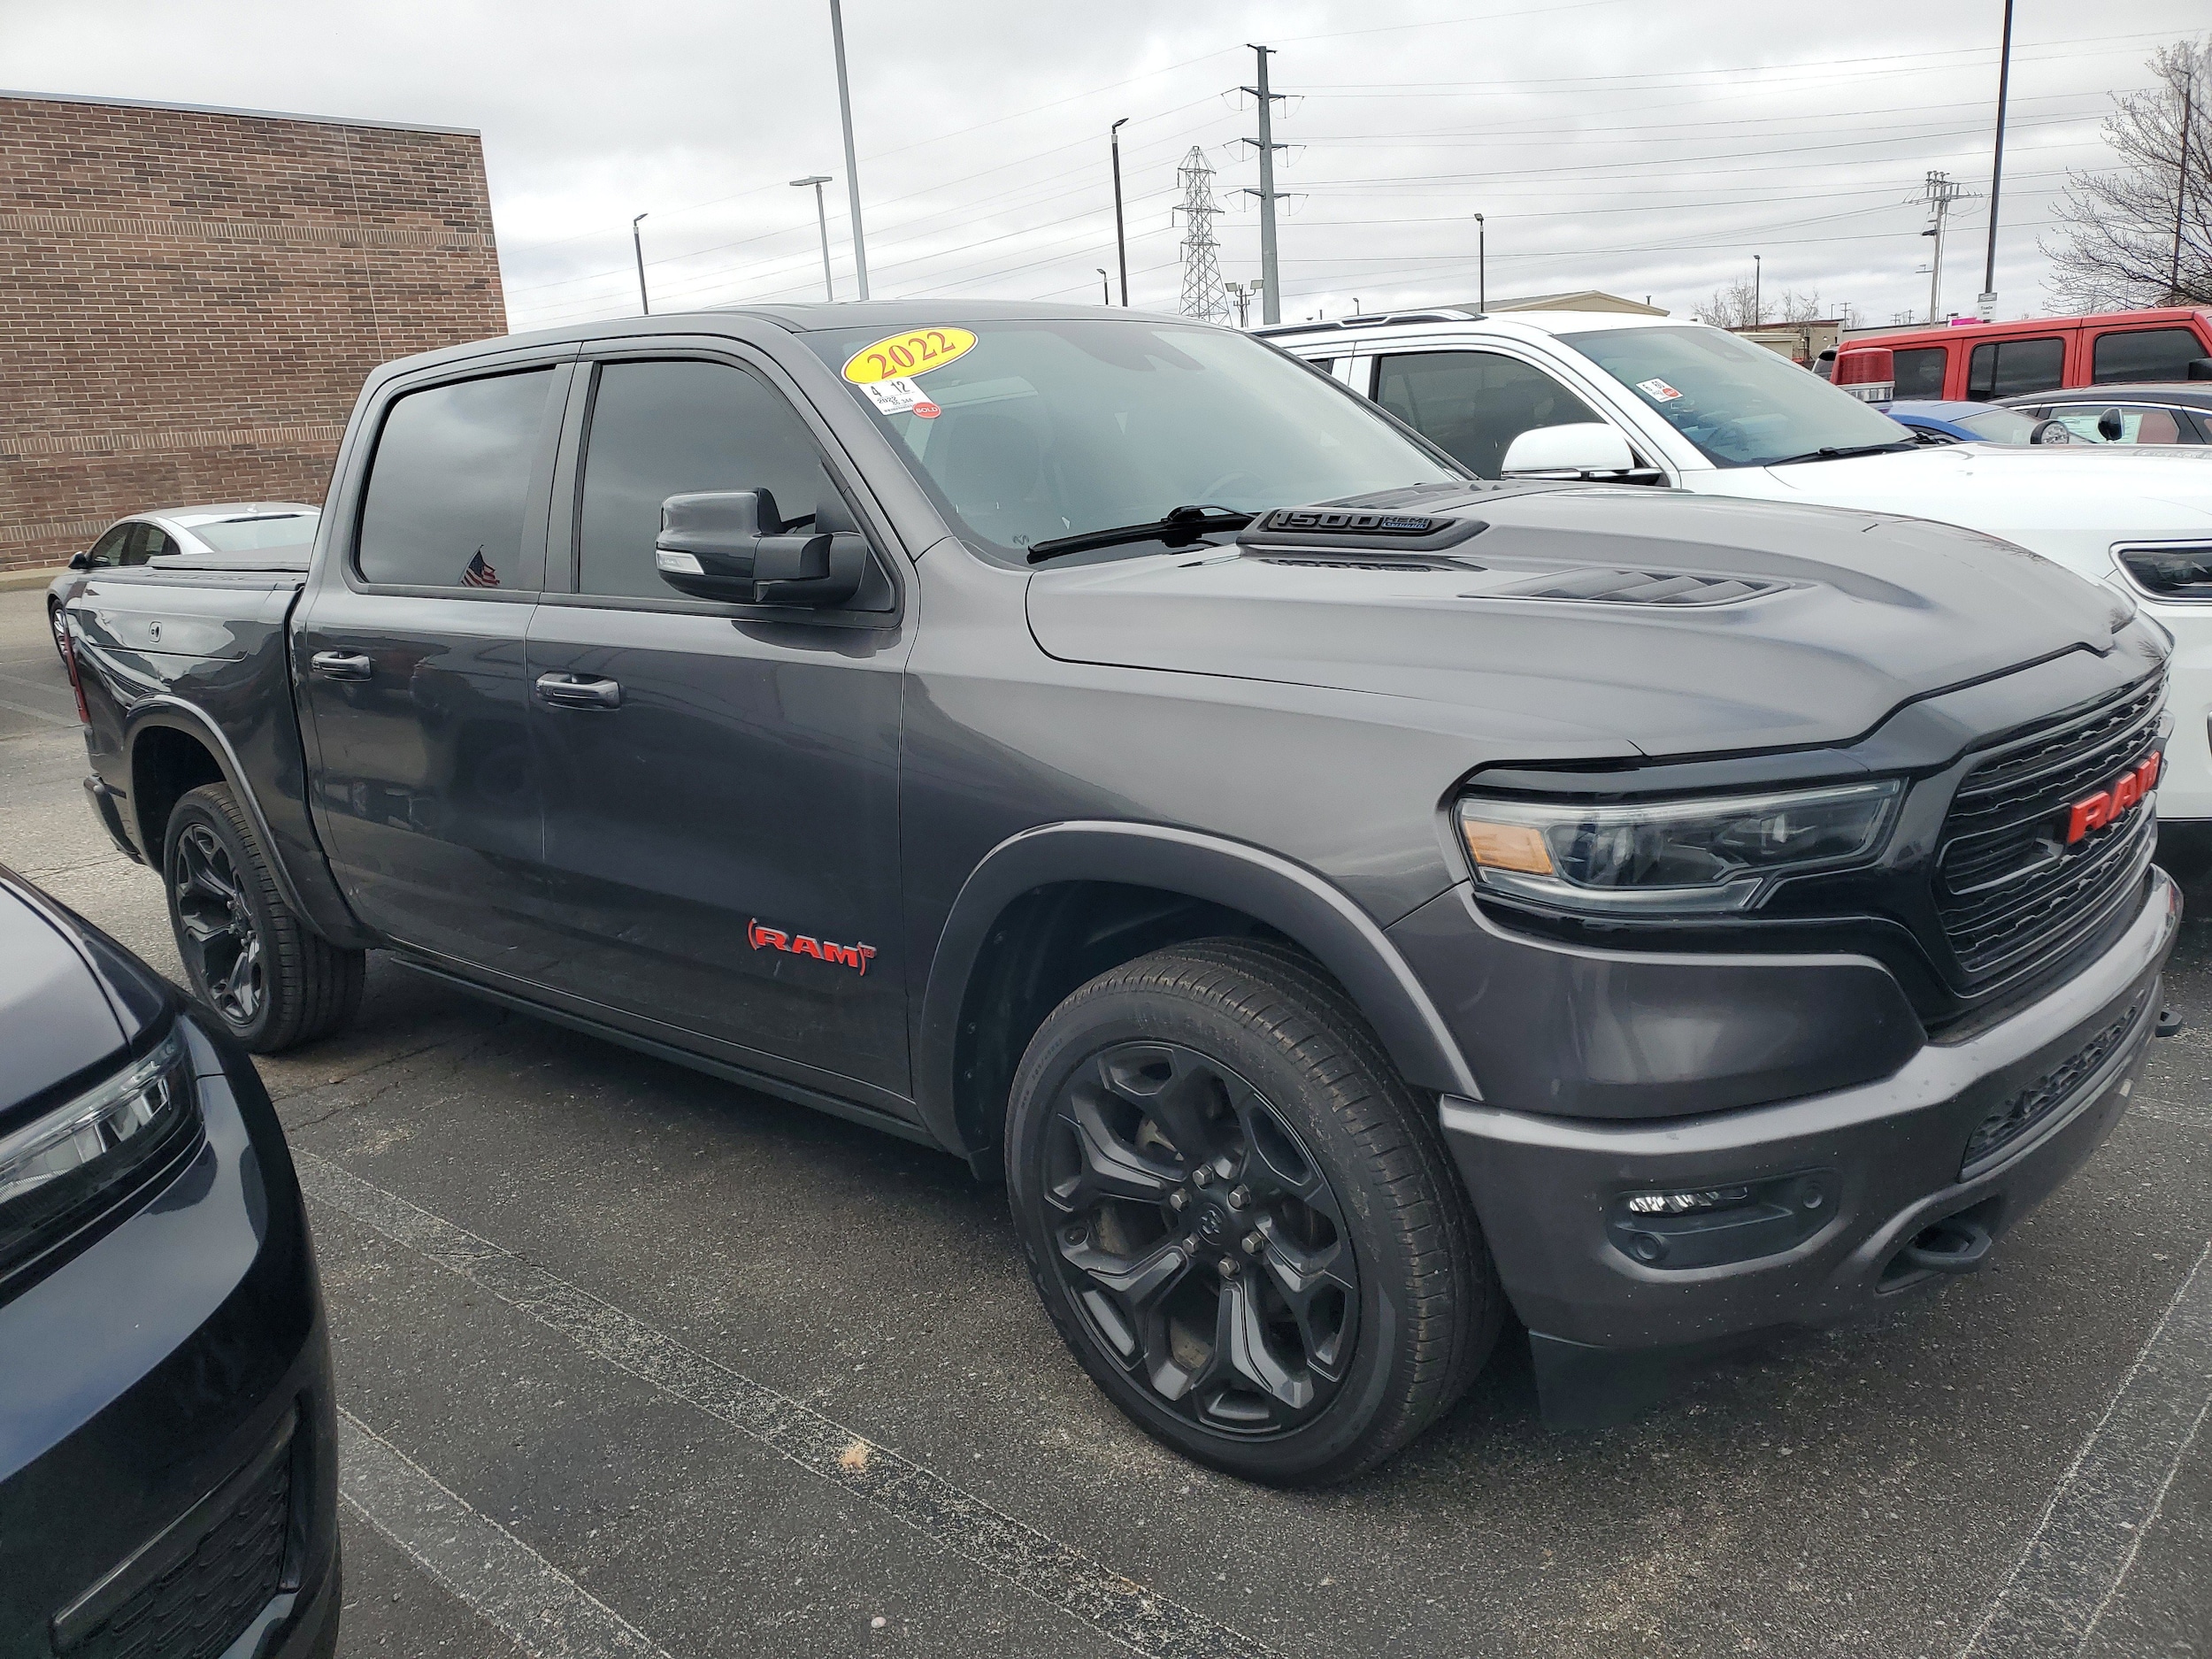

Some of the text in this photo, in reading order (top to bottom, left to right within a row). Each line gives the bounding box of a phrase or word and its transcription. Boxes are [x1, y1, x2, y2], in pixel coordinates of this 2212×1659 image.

[867, 332, 956, 380] 2022
[871, 380, 911, 397] 4 12
[1277, 511, 1383, 528] 1500
[2067, 750, 2161, 844] RAM
